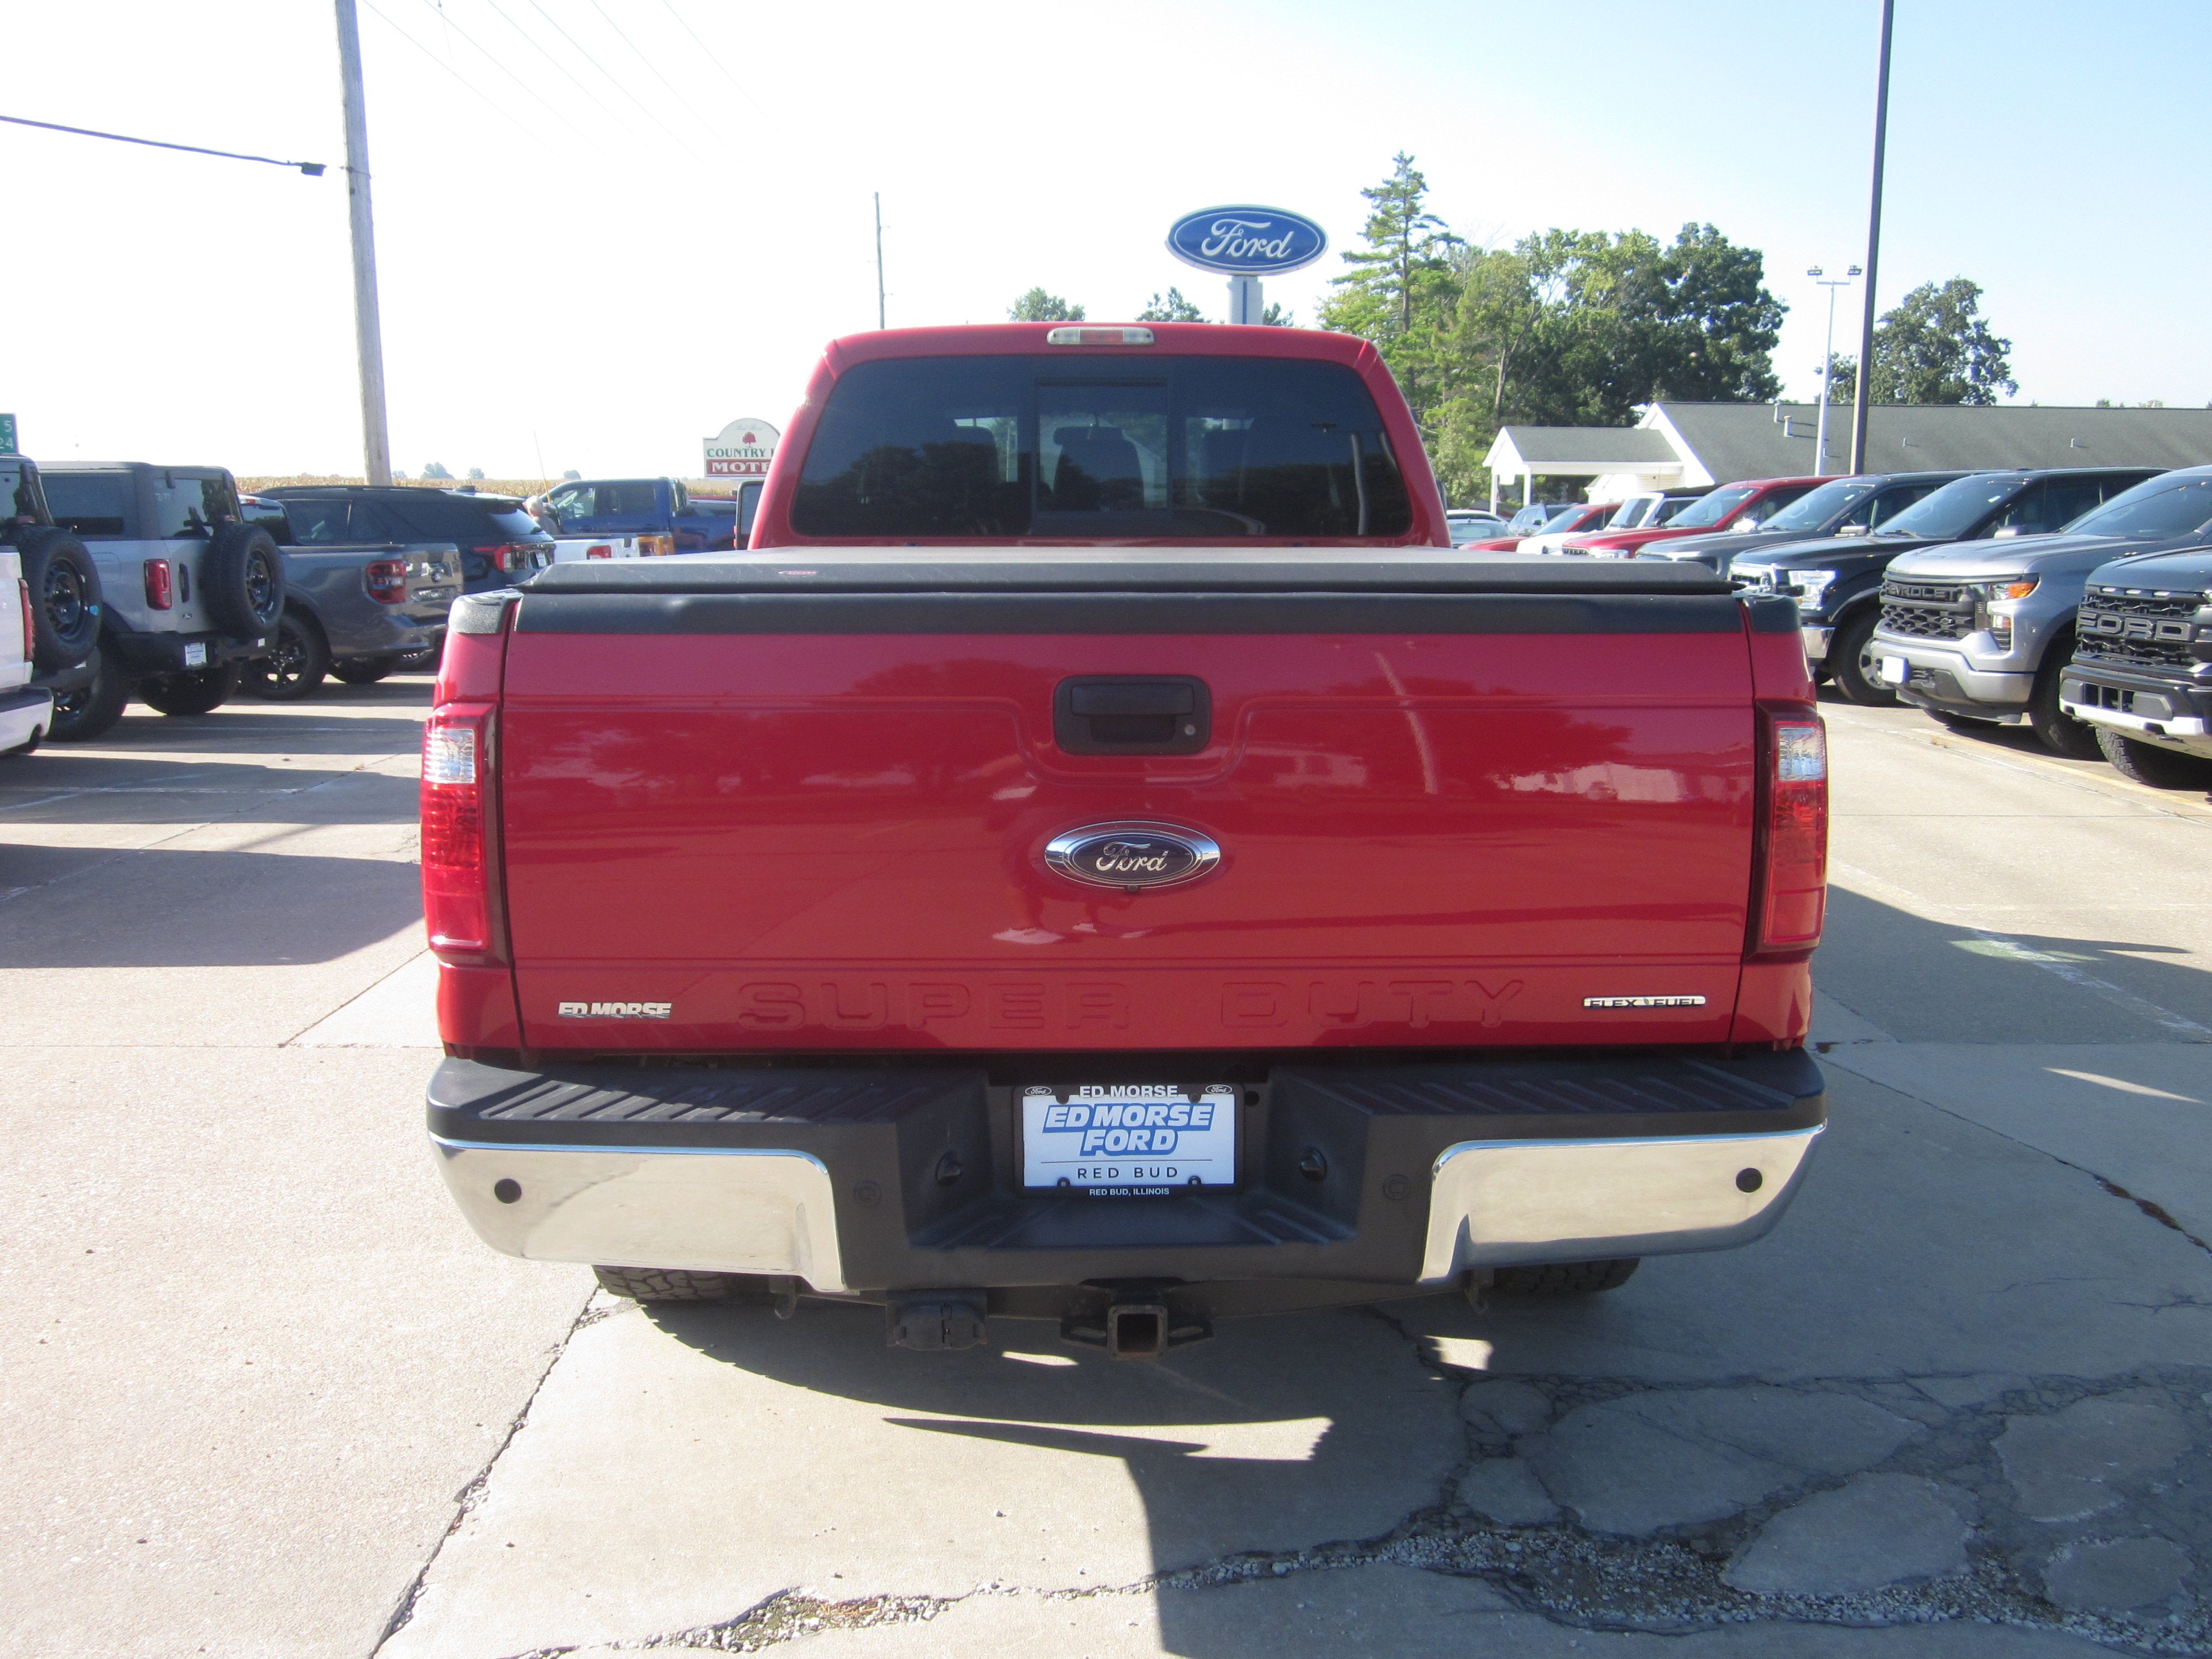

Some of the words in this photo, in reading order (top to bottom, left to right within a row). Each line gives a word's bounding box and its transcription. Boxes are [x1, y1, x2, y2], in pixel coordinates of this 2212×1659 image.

[1201, 218, 1294, 258] Ford
[4, 420, 13, 432] 5
[707, 448, 765, 457] COUNTRY
[712, 461, 770, 472] MOTE
[2077, 610, 2194, 642] FORD
[1095, 841, 1168, 872] Ford
[558, 1001, 588, 1019] ED
[591, 1001, 672, 1019] MORSE
[738, 982, 1130, 1031] SUPER
[1220, 979, 1525, 1029] DUTY
[1590, 998, 1637, 1008] FLEX
[1653, 997, 1702, 1006] FUEL
[1079, 1086, 1104, 1098] ED
[1110, 1085, 1178, 1098] MORSE
[1045, 1106, 1090, 1128] ED
[1092, 1105, 1212, 1127] MORSE
[1082, 1129, 1176, 1152] FORD
[1078, 1167, 1119, 1179] RED
[1134, 1167, 1178, 1178] BUD
